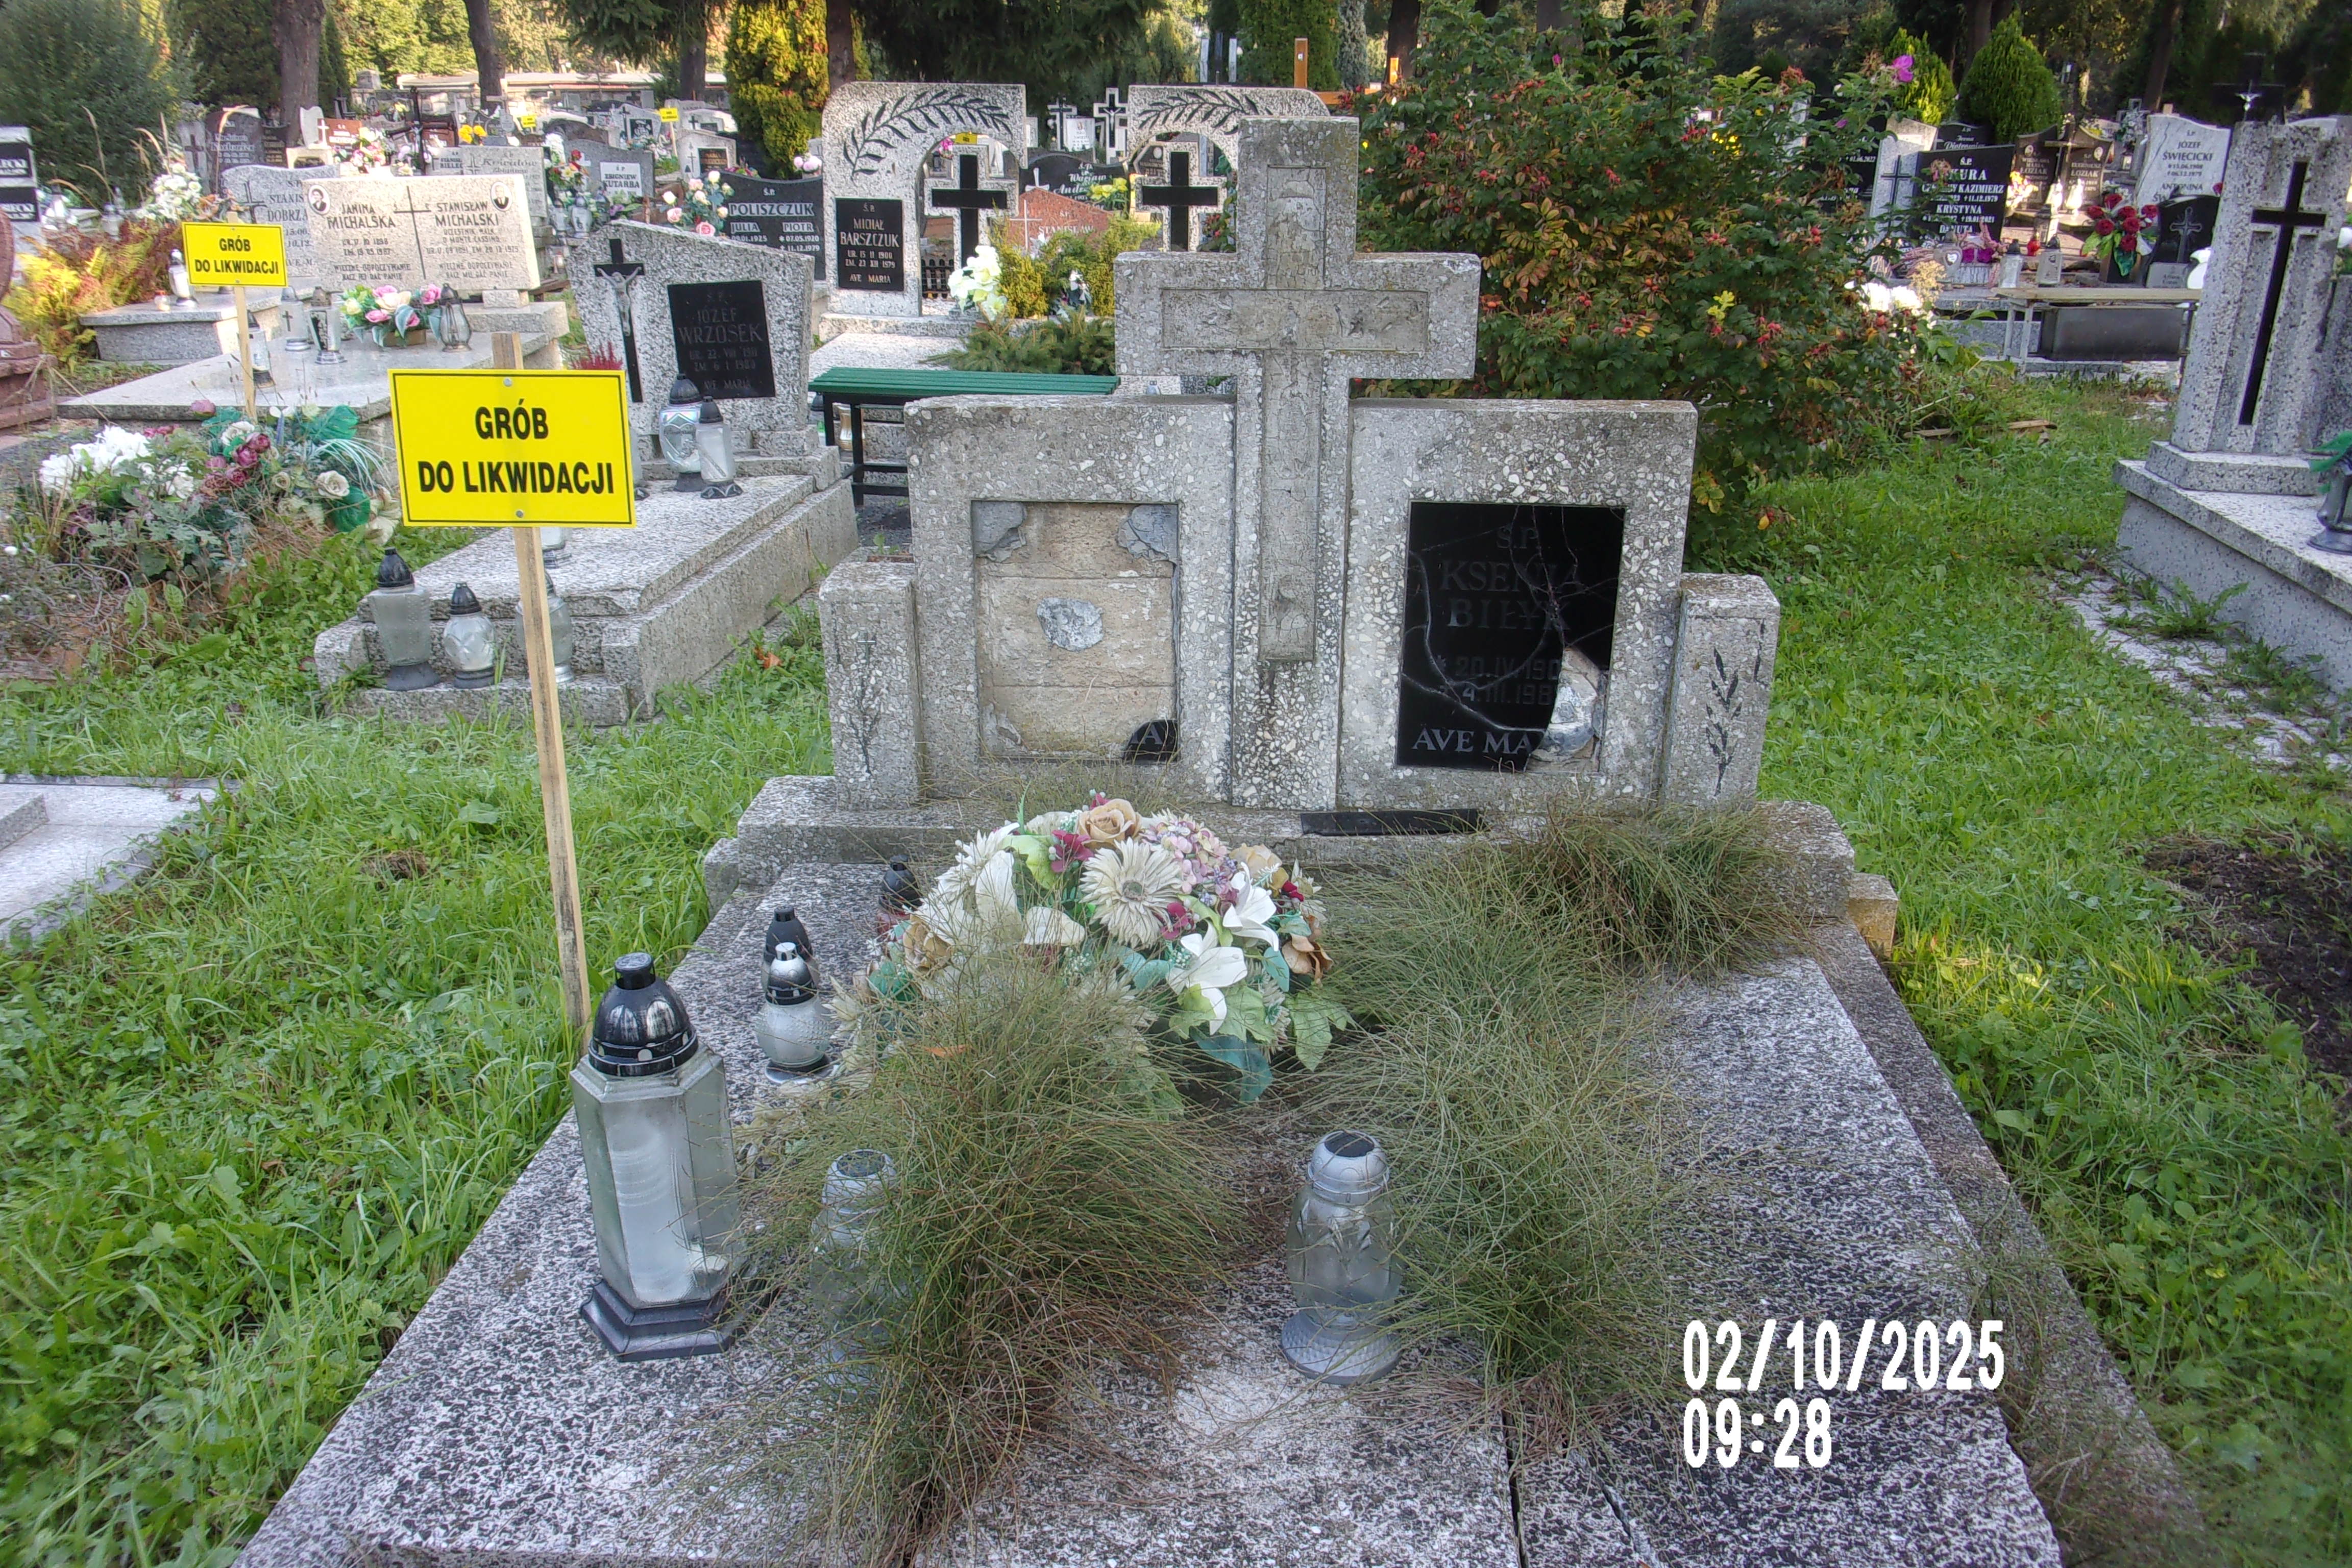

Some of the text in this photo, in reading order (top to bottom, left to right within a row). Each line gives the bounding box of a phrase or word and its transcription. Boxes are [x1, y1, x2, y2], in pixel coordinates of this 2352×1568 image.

[1958, 184, 2004, 193] KAZIMIERZ
[341, 204, 375, 214] JANINA
[436, 201, 488, 212] STANISŁAW
[728, 203, 815, 216] POLISZCZUK
[1936, 204, 1982, 213] KRYSTYNA
[327, 216, 396, 229] MICHALSKA
[435, 213, 499, 227] MICHALSKI
[853, 218, 885, 230] MICHAŁ
[730, 222, 814, 234] JULIA PIOTR
[219, 236, 251, 252] GRÓB
[840, 232, 900, 248] BARSZCZUK
[194, 259, 279, 274] DO LIKWIDACJI
[849, 274, 891, 283] AVE MARIA
[678, 323, 764, 345] WRZOSEK
[475, 399, 549, 440] GRÓB
[418, 460, 614, 495] DO LIKWIDACJI
[1412, 727, 1475, 752] AVE
